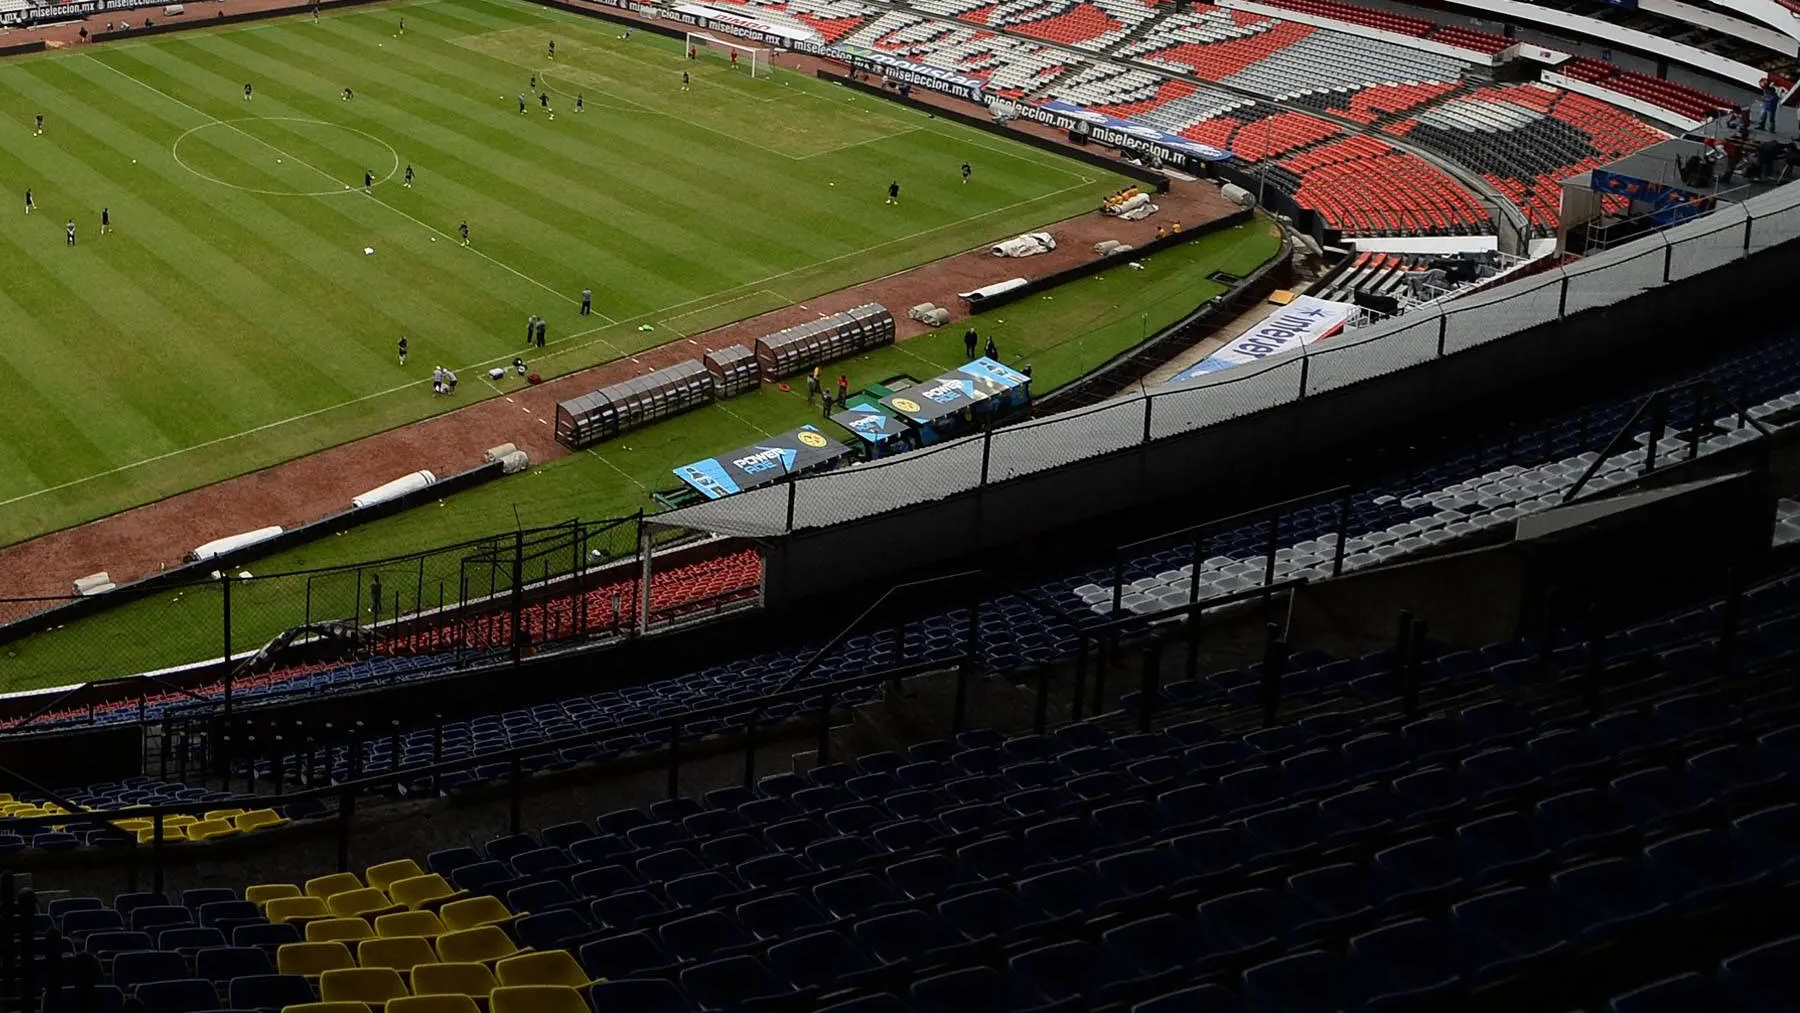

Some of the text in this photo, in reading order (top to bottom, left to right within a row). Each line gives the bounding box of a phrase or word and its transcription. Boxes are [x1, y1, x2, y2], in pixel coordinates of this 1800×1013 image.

[29, 2, 95, 18] miseleccion.mx
[709, 19, 780, 46] miseleccion.mx
[885, 66, 970, 99] miseleccion.mx
[922, 379, 965, 400] POWER
[733, 447, 785, 470] POWER
